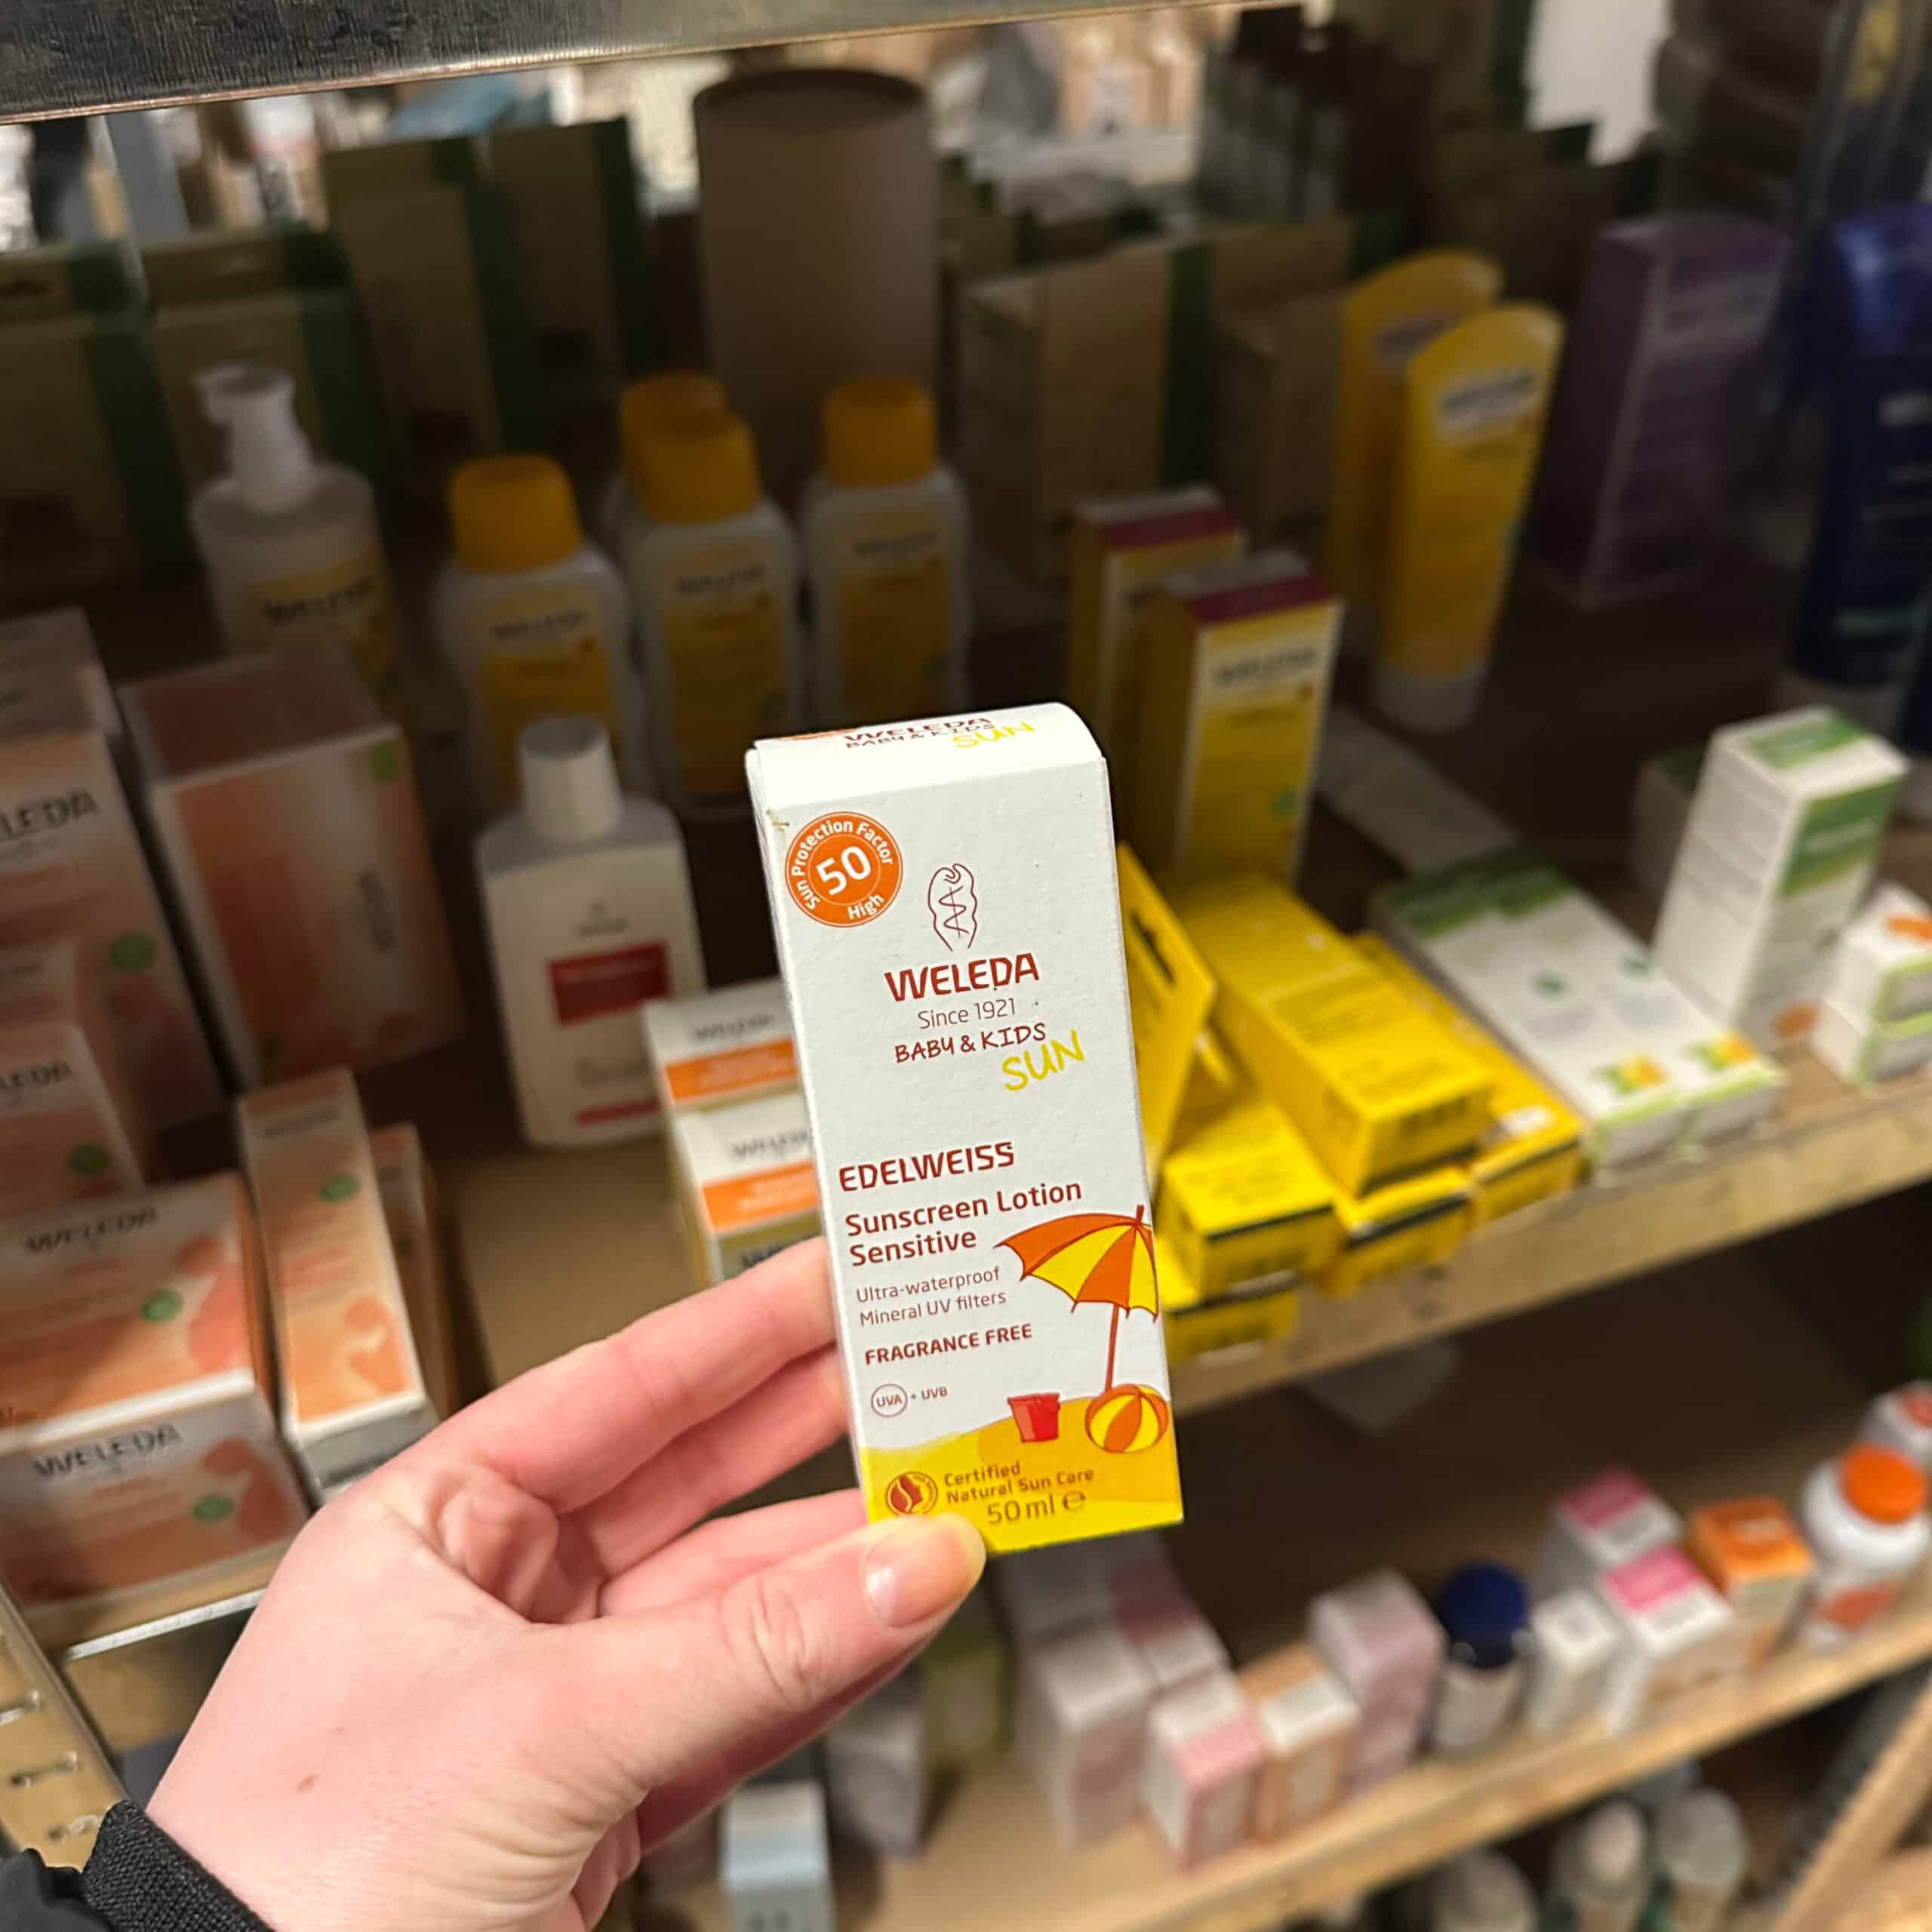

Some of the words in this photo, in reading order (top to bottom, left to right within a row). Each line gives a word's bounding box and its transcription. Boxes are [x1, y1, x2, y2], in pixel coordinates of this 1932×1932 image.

[843, 718, 992, 741] WELEDA
[845, 735, 904, 748] BABY
[931, 723, 995, 737] KIDS
[952, 721, 1036, 749] SUN
[791, 820, 854, 876] Protection
[857, 822, 894, 864] Factor
[816, 845, 872, 895] 50
[797, 879, 820, 910] Sun
[848, 894, 884, 920] High
[884, 952, 1039, 1002] WELEDA
[918, 1009, 969, 1029] Since
[974, 998, 1016, 1020] 1921
[894, 1037, 954, 1063] BABY
[960, 1035, 976, 1052] &
[981, 1023, 1046, 1050] KIDS
[1002, 1029, 1084, 1091] SUN
[838, 1141, 1014, 1192] EDELWEISS
[845, 1198, 988, 1236] Sunscreen
[996, 1183, 1082, 1212] Lotion
[850, 1231, 977, 1266] Sensitive
[857, 1266, 1000, 1303] Ultra-waterproof
[860, 1304, 921, 1327] Mineral
[927, 1298, 951, 1315] UV
[955, 1292, 1007, 1311] filters
[865, 1332, 980, 1365] FRAGRANCE
[985, 1323, 1032, 1345] FREE
[876, 1394, 903, 1407] UVA
[921, 1386, 948, 1400] UVB
[944, 1461, 1021, 1487] Certified
[947, 1481, 1013, 1504] Natural
[1019, 1476, 1051, 1492] Sun
[1057, 1469, 1094, 1486] Care
